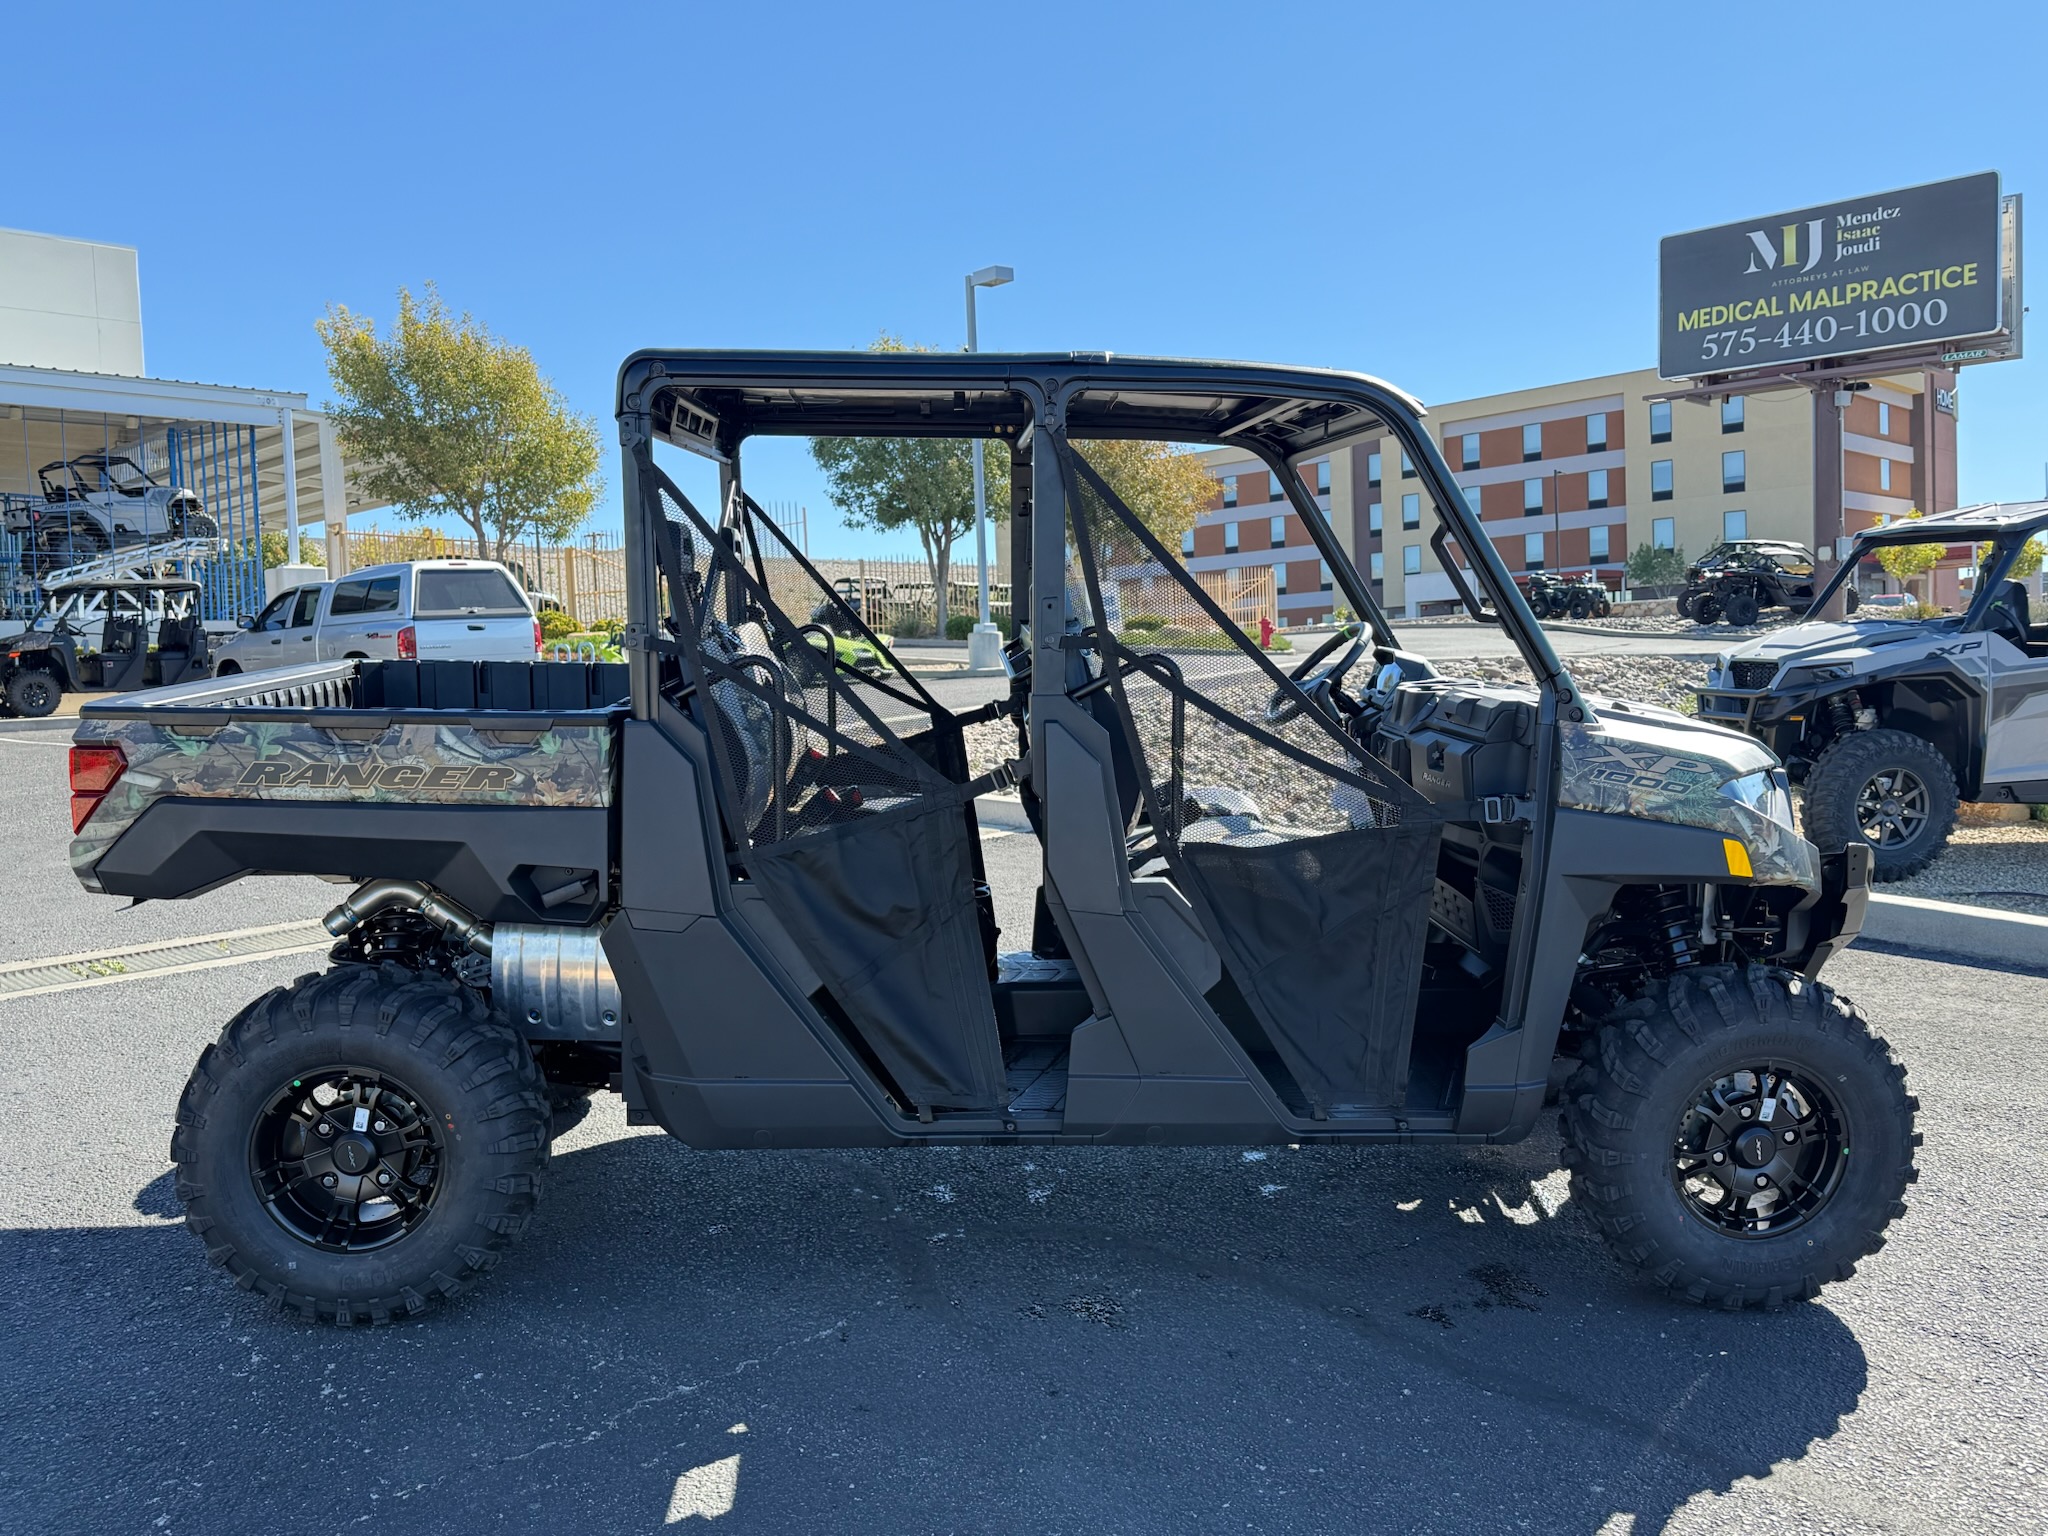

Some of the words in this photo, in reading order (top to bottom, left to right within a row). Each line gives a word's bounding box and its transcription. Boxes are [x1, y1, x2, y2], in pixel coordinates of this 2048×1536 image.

[1836, 206, 1901, 229] Mendez
[1836, 225, 1881, 243] Isaac
[1834, 237, 1881, 262] Joudi
[1771, 272, 1828, 288] ATTORNEYS
[1831, 269, 1844, 278] AT
[1848, 265, 1870, 275] LAW
[1678, 296, 1784, 332] MEDICAL
[1789, 262, 1978, 314] MALPRACTICE
[1701, 298, 1948, 360] 575-440-1000
[1944, 350, 1983, 361] LAMAR
[1935, 640, 1983, 656] XP
[1578, 744, 1715, 775] XP
[237, 761, 517, 792] RANGER
[1422, 772, 1451, 788] RANGER
[1590, 768, 1693, 795] 1000
